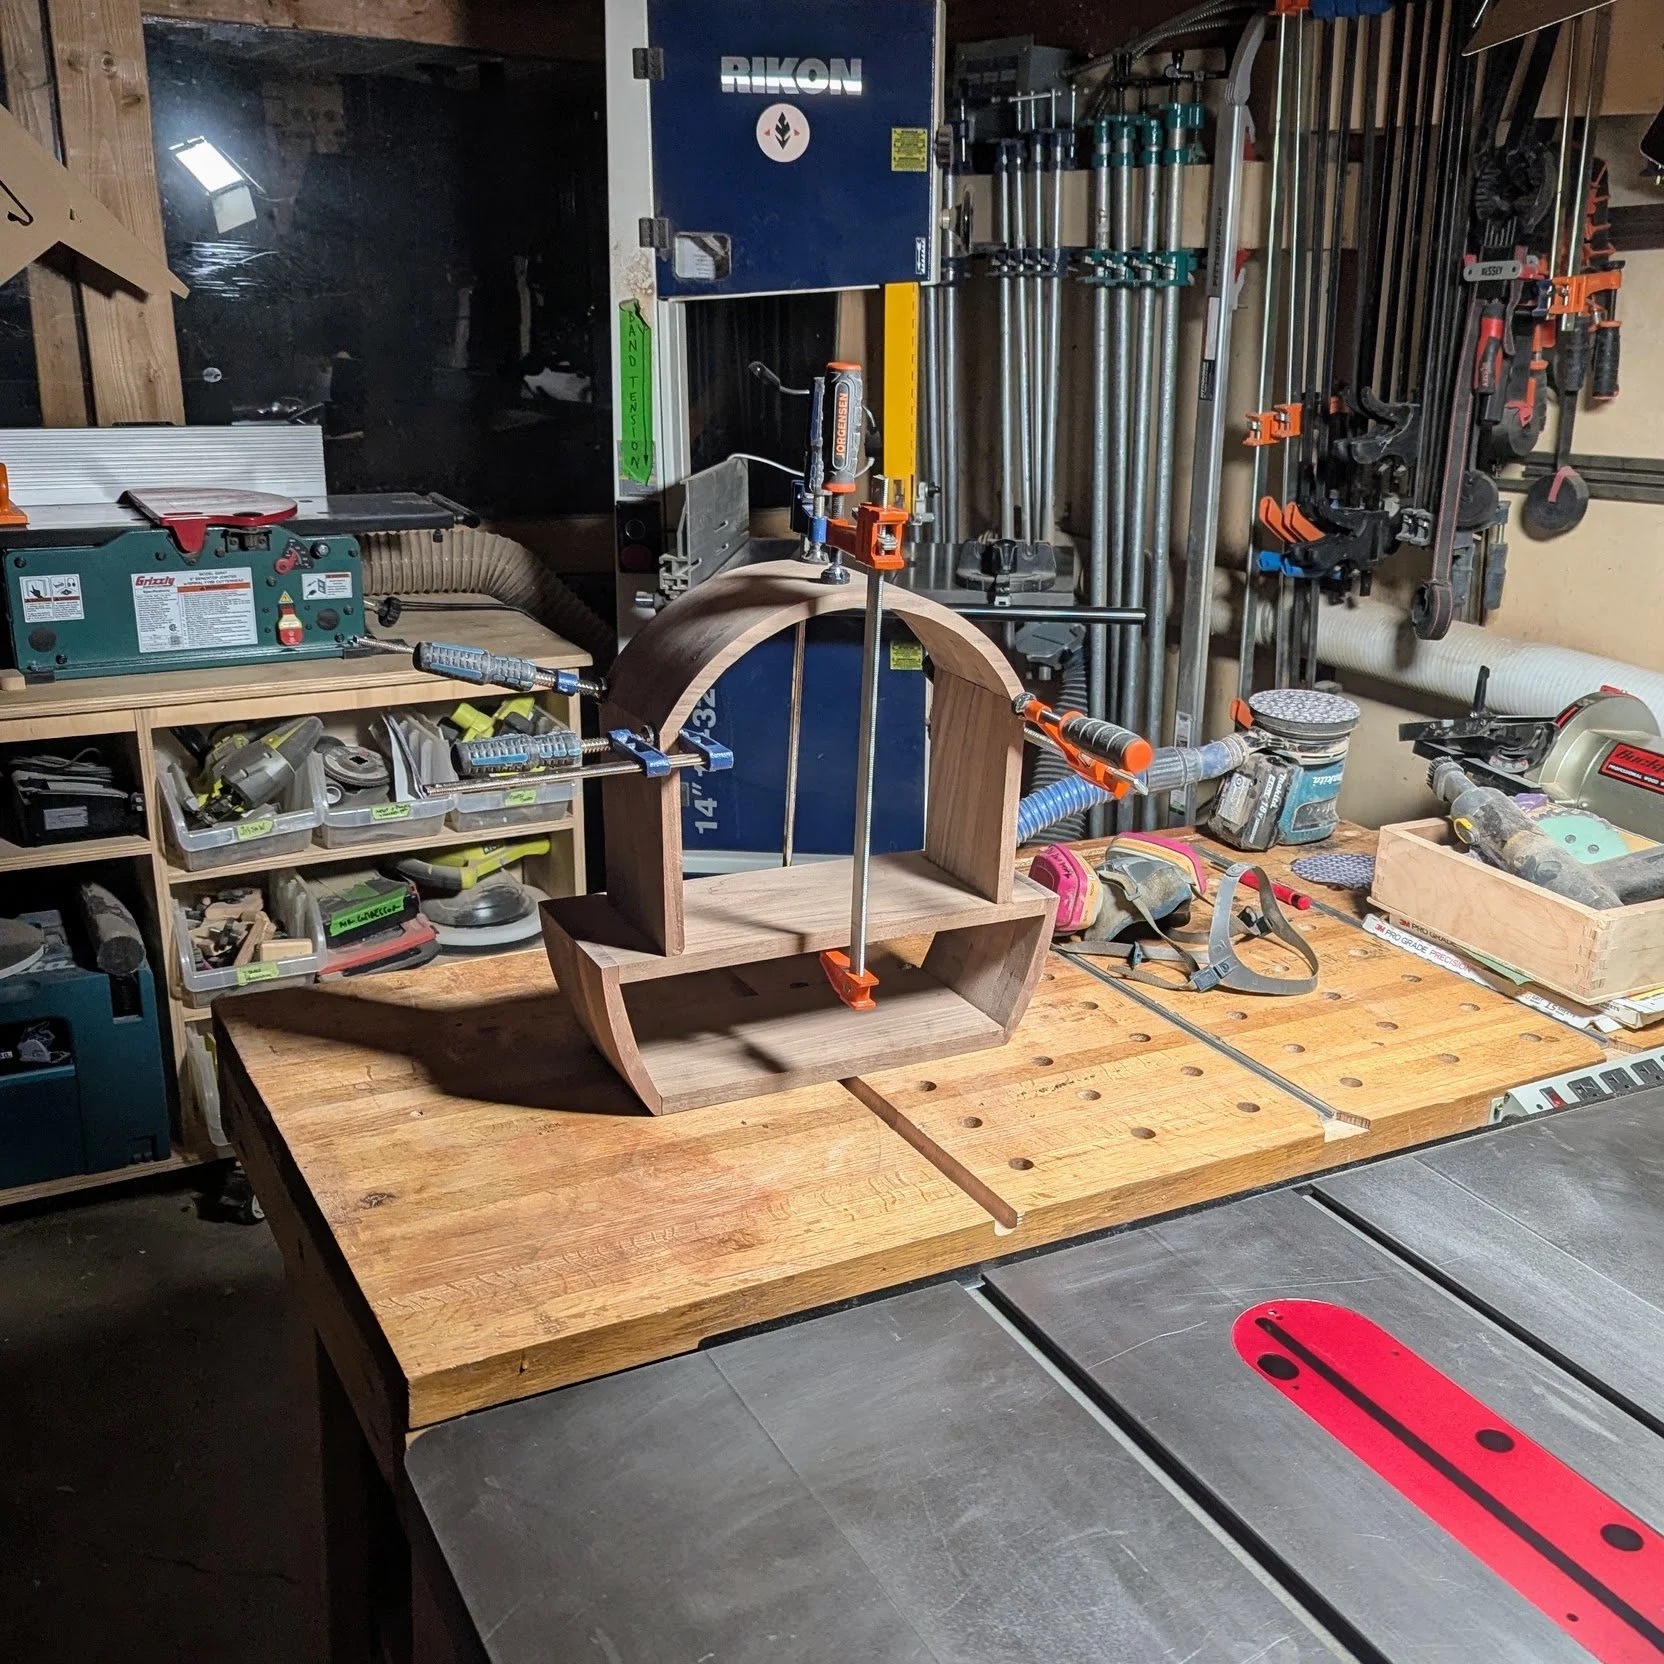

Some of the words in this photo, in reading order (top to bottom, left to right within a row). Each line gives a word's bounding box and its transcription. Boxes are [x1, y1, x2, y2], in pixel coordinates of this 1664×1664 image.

[721, 56, 862, 96] RIKON
[628, 311, 638, 367] BAND
[629, 376, 640, 470] TENSION
[836, 392, 848, 459] JORGENSEN
[135, 576, 175, 587] Grizzly
[692, 781, 718, 835] 14"
[1270, 773, 1287, 809] makita
[1374, 923, 1386, 933] 3M
[1385, 930, 1401, 941] PRO
[1401, 937, 1428, 954] GRADE
[1429, 949, 1472, 973] PRECISION
[1411, 923, 1428, 935] PRO
